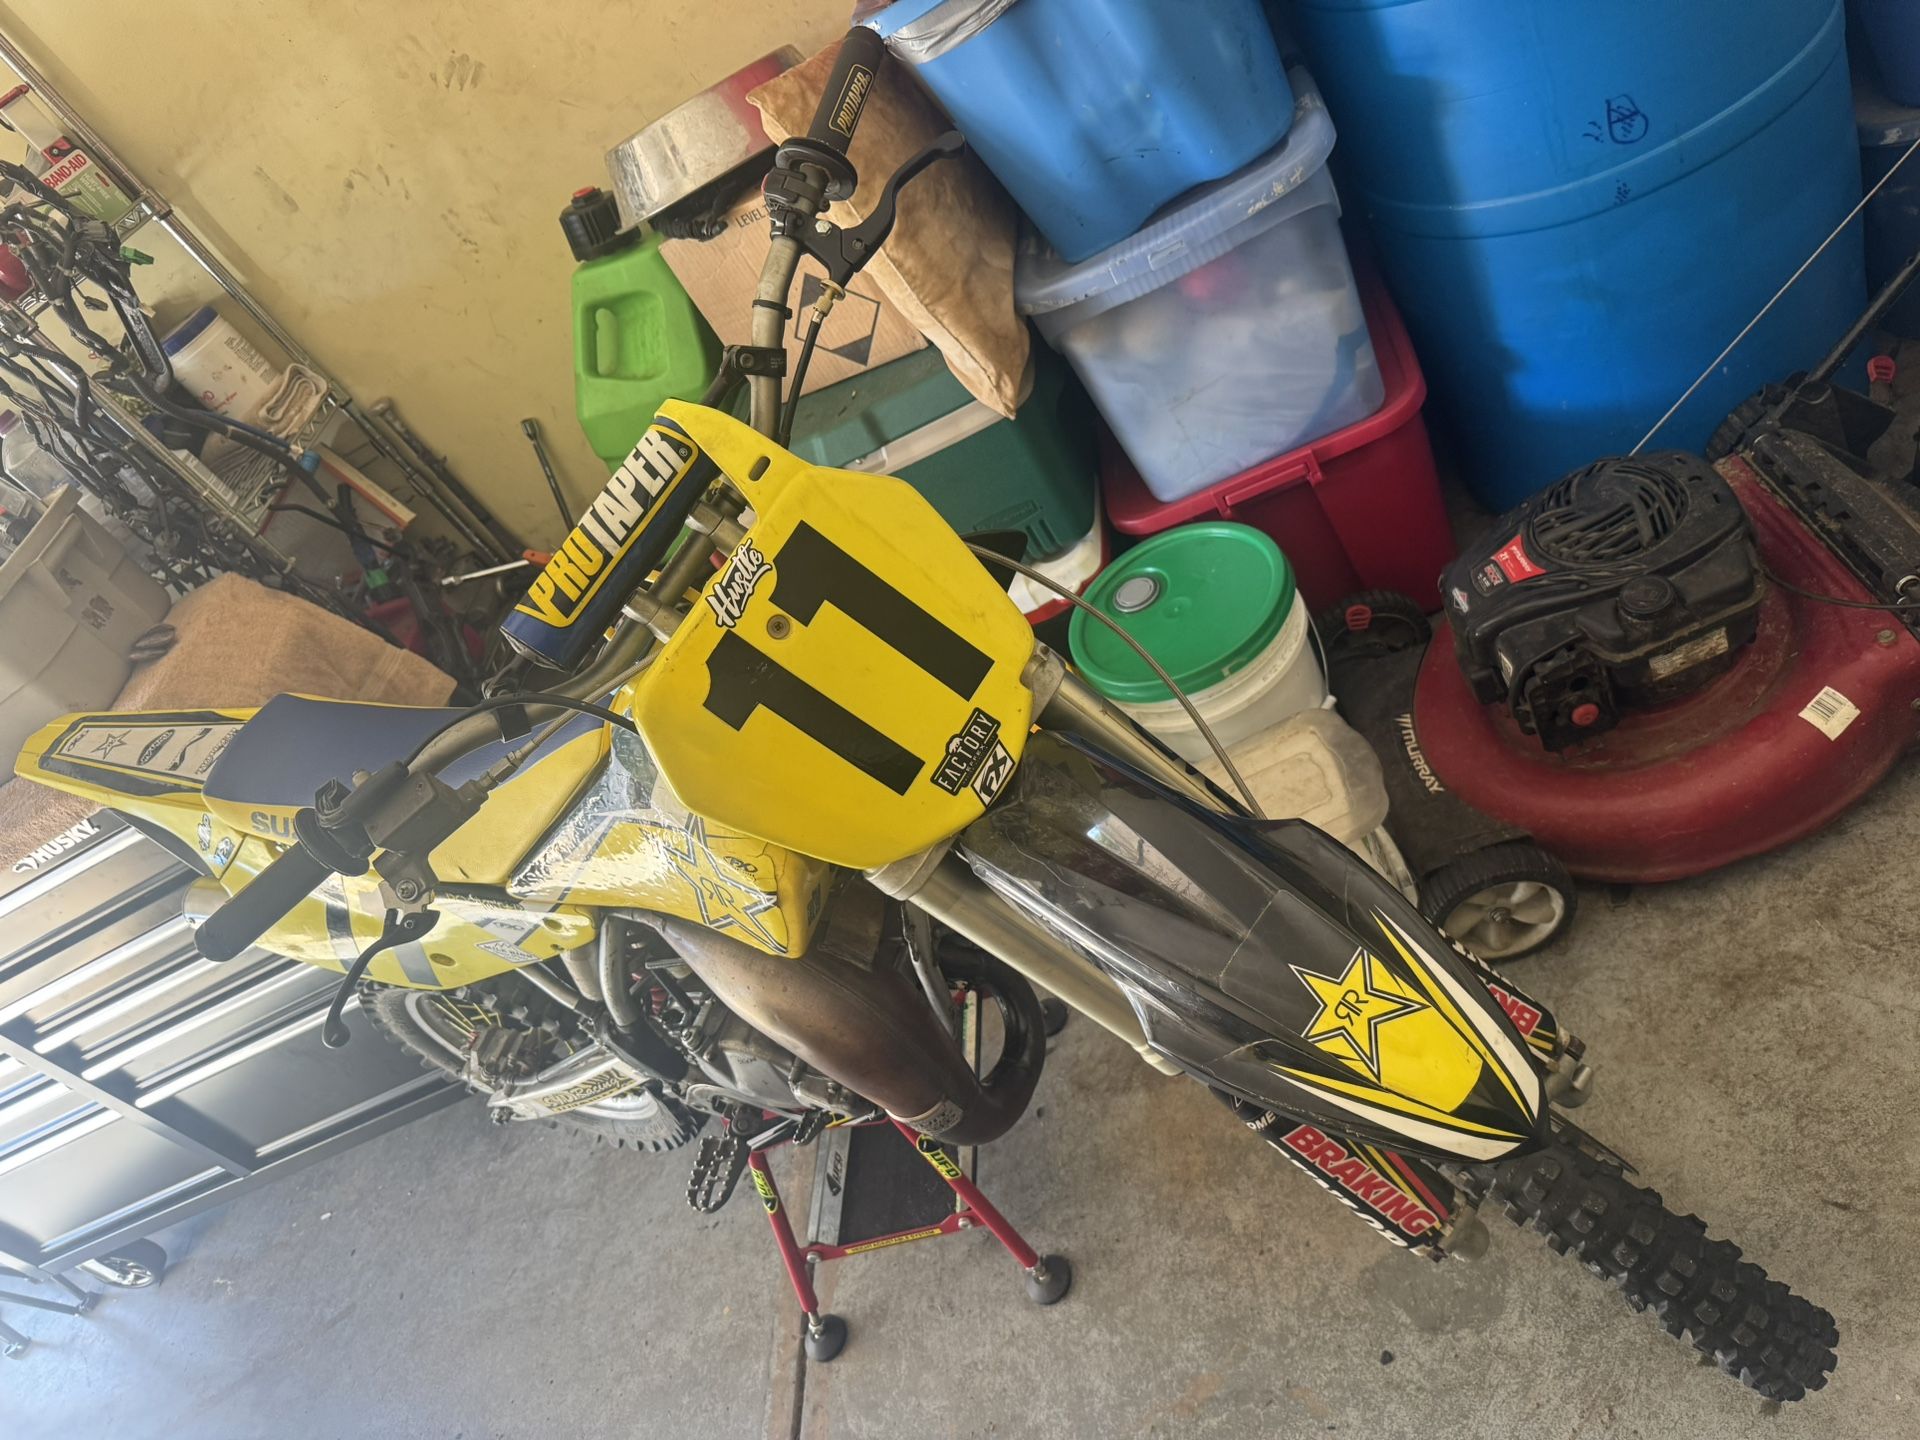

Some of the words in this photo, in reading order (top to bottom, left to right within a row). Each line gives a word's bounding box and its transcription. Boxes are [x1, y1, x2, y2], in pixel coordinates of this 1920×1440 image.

[837, 71, 868, 132] PROTAPER
[43, 153, 87, 189] BAND-AID
[735, 207, 766, 228] LEVEL
[527, 427, 687, 621] PROTAPER
[706, 538, 772, 627] Hustle
[937, 713, 993, 791] FACTORY
[36, 819, 98, 864] HUSKY
[931, 1152, 959, 1177] UFO
[1280, 1124, 1439, 1237] BRAKING
